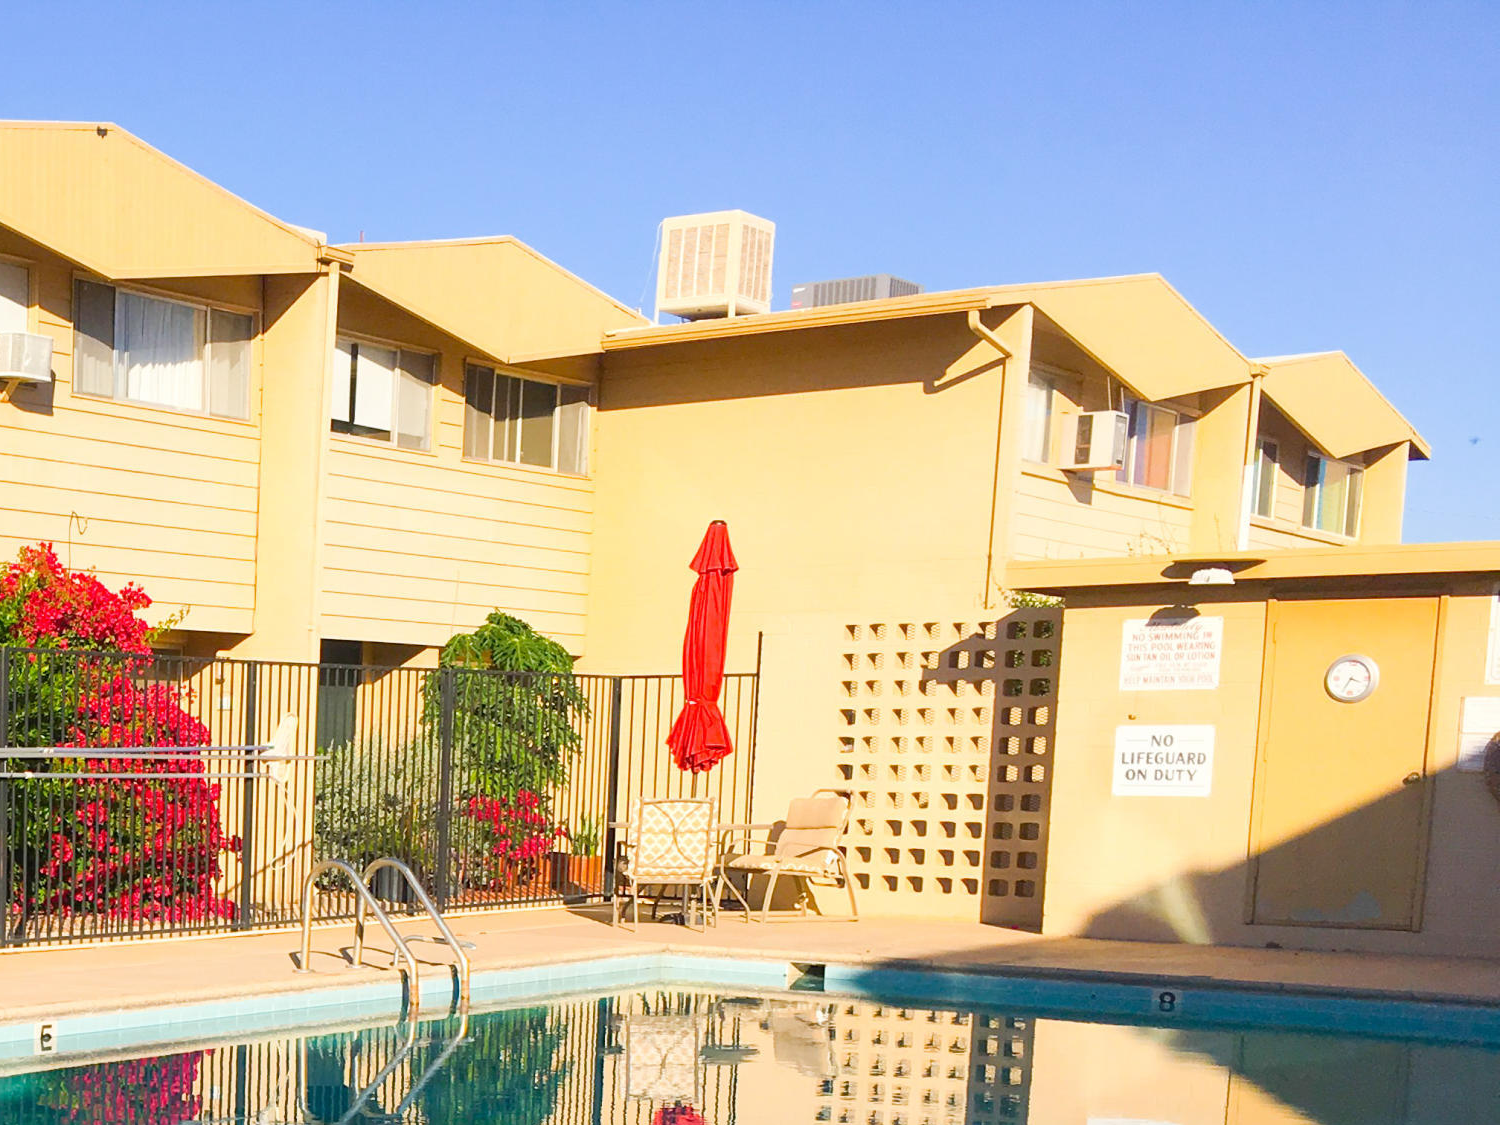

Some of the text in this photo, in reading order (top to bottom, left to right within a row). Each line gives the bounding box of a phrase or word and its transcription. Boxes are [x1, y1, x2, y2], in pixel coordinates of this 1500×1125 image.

[1132, 633, 1145, 642] NO
[1148, 631, 1199, 641] SWIMMING
[1128, 641, 1216, 652] THIS POOL WEARING
[1126, 653, 1140, 662] SUN
[1143, 653, 1157, 661] TAN
[1160, 652, 1171, 661] OIL
[1188, 651, 1216, 660] LOTION
[1143, 675, 1175, 684] MAINTAIN
[1151, 735, 1174, 747] NO
[1121, 751, 1207, 765] LIFEGUARD
[1125, 769, 1197, 781] ON DUTY
[1159, 992, 1176, 1011] 8
